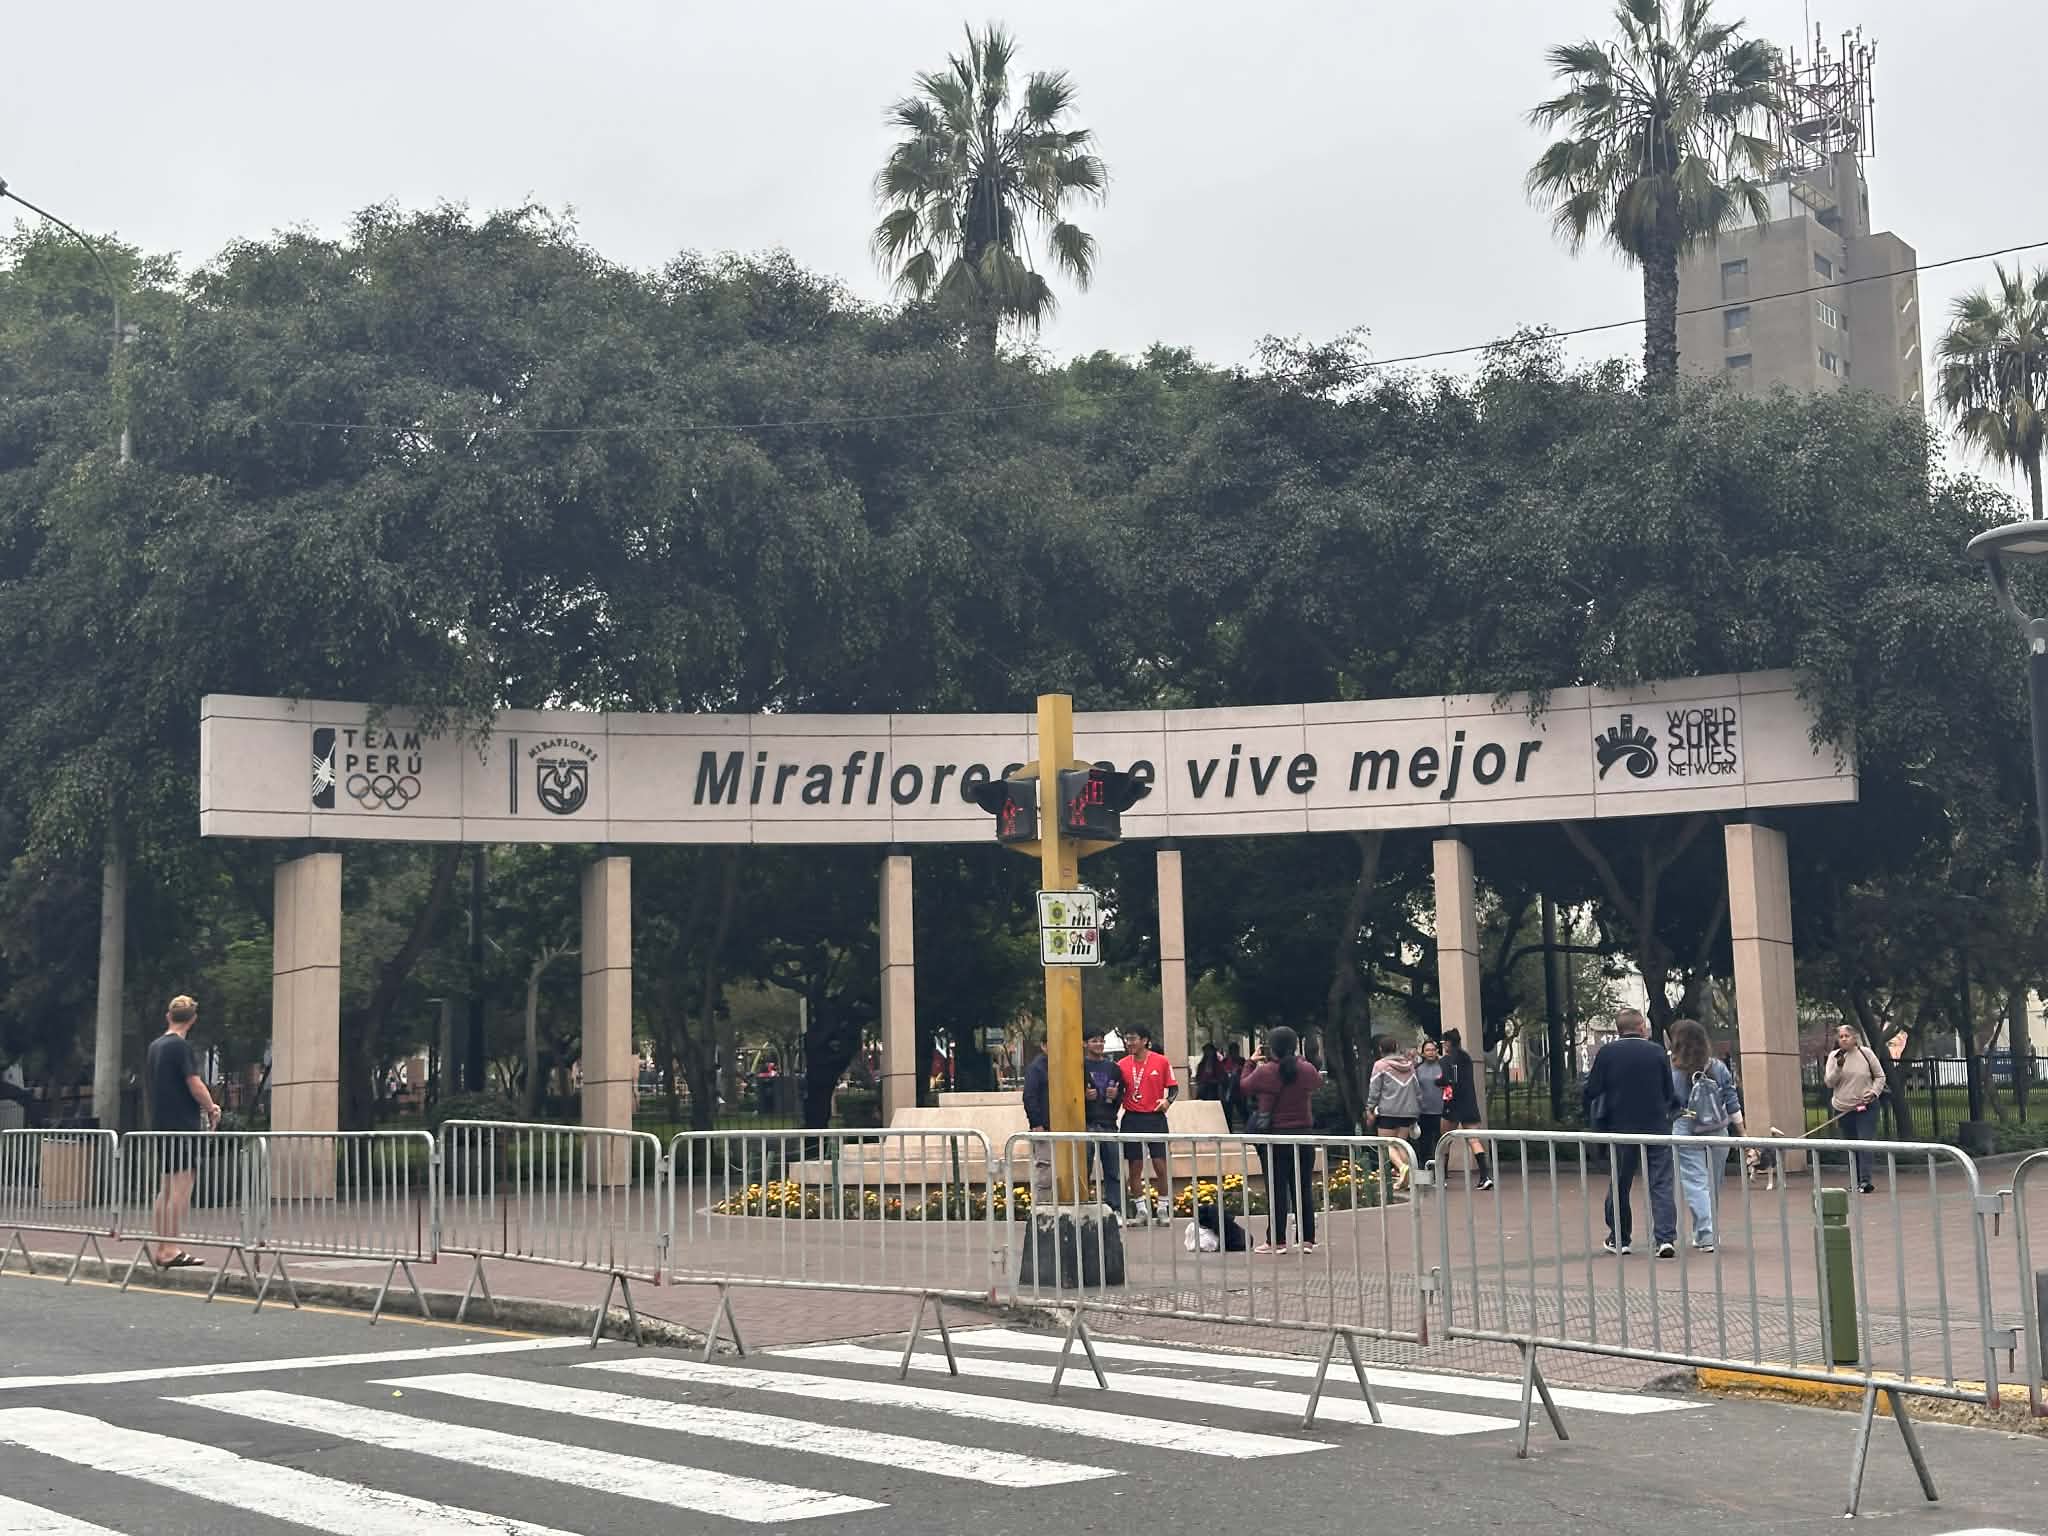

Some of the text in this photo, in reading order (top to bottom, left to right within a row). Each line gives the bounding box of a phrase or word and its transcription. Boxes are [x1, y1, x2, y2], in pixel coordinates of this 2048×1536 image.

[1666, 707, 1737, 727] WORLD
[342, 728, 422, 751] TEAM
[1668, 720, 1737, 749] SURF
[528, 737, 599, 762] MIRAFLORES
[1668, 744, 1737, 767] CITIES
[345, 750, 423, 775] PERÚ
[1187, 744, 1318, 799] vive
[1348, 730, 1543, 801] mejor
[1668, 762, 1737, 777] NETWORK
